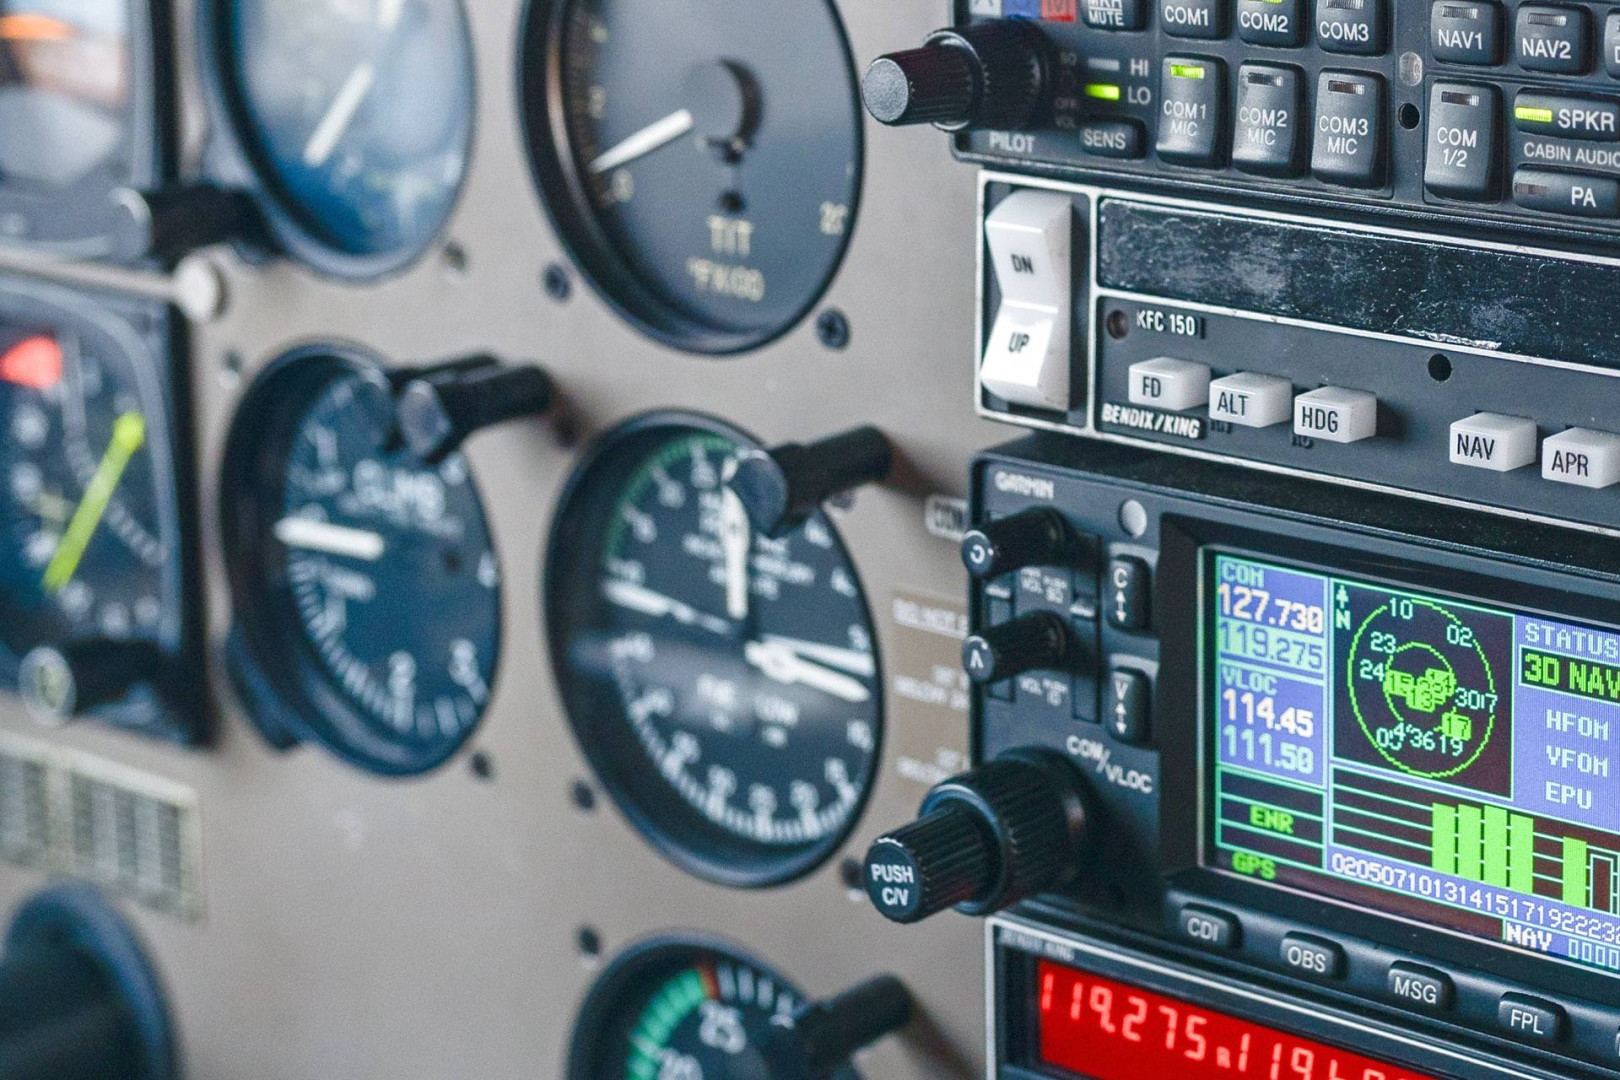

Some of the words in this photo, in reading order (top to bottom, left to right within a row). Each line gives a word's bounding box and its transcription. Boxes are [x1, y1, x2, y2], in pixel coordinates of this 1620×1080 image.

[1088, 10, 1124, 26] MUTE
[1163, 5, 1210, 27] COM1
[1239, 10, 1289, 33] COM2
[1319, 21, 1370, 42] COM3
[1437, 29, 1484, 51] NAV1
[1521, 38, 1571, 60] NAV2
[1128, 58, 1149, 77] HI
[1127, 86, 1151, 105] LO
[1238, 106, 1288, 127] COM2
[1318, 115, 1369, 136] COM3
[1557, 109, 1615, 133] SPKR
[1082, 128, 1127, 150] SENS
[1170, 121, 1198, 137] MIC
[1246, 125, 1276, 146] MIC
[1436, 126, 1478, 148] COM
[988, 131, 1036, 153] PILOT
[1326, 135, 1358, 156] MIC
[1523, 142, 1572, 163] CABIN
[1441, 148, 1468, 168] 1/2
[1570, 186, 1597, 208] PA
[1136, 309, 1165, 332] KFC
[1169, 314, 1196, 337] 150
[1008, 330, 1031, 354] UP
[1142, 376, 1162, 399] FD
[1216, 391, 1250, 417] ALT
[1101, 402, 1202, 440] BENDIX/KING
[1301, 406, 1339, 433] HDG
[1456, 432, 1496, 461] NAV
[1551, 450, 1590, 478] APR
[1113, 567, 1129, 588] C
[1221, 561, 1265, 588] COM
[1217, 582, 1325, 634] 127.730
[1335, 609, 1351, 630] N
[1389, 598, 1414, 620] 10
[1219, 621, 1323, 670] 119.275
[1370, 631, 1397, 654] 23
[1446, 624, 1473, 648] 02
[1524, 622, 1620, 660] STATUS
[1220, 666, 1278, 696] VLOC
[1359, 659, 1385, 683] 24
[1523, 652, 1561, 686] 3D
[1113, 681, 1129, 700] V
[1222, 688, 1314, 738] 114.45
[1546, 708, 1610, 742] HFOM
[1222, 724, 1314, 775] 111.50
[1546, 744, 1609, 778] VFOM
[1545, 780, 1593, 811] EPU
[1250, 805, 1294, 835] ENR
[870, 863, 914, 884] PUSH
[1231, 851, 1276, 881] GPS
[1186, 917, 1220, 943] CDI
[1505, 920, 1553, 952] NAV
[1286, 945, 1327, 974] OBS
[1393, 975, 1439, 1004] MSG
[1509, 1008, 1545, 1036] FPL
